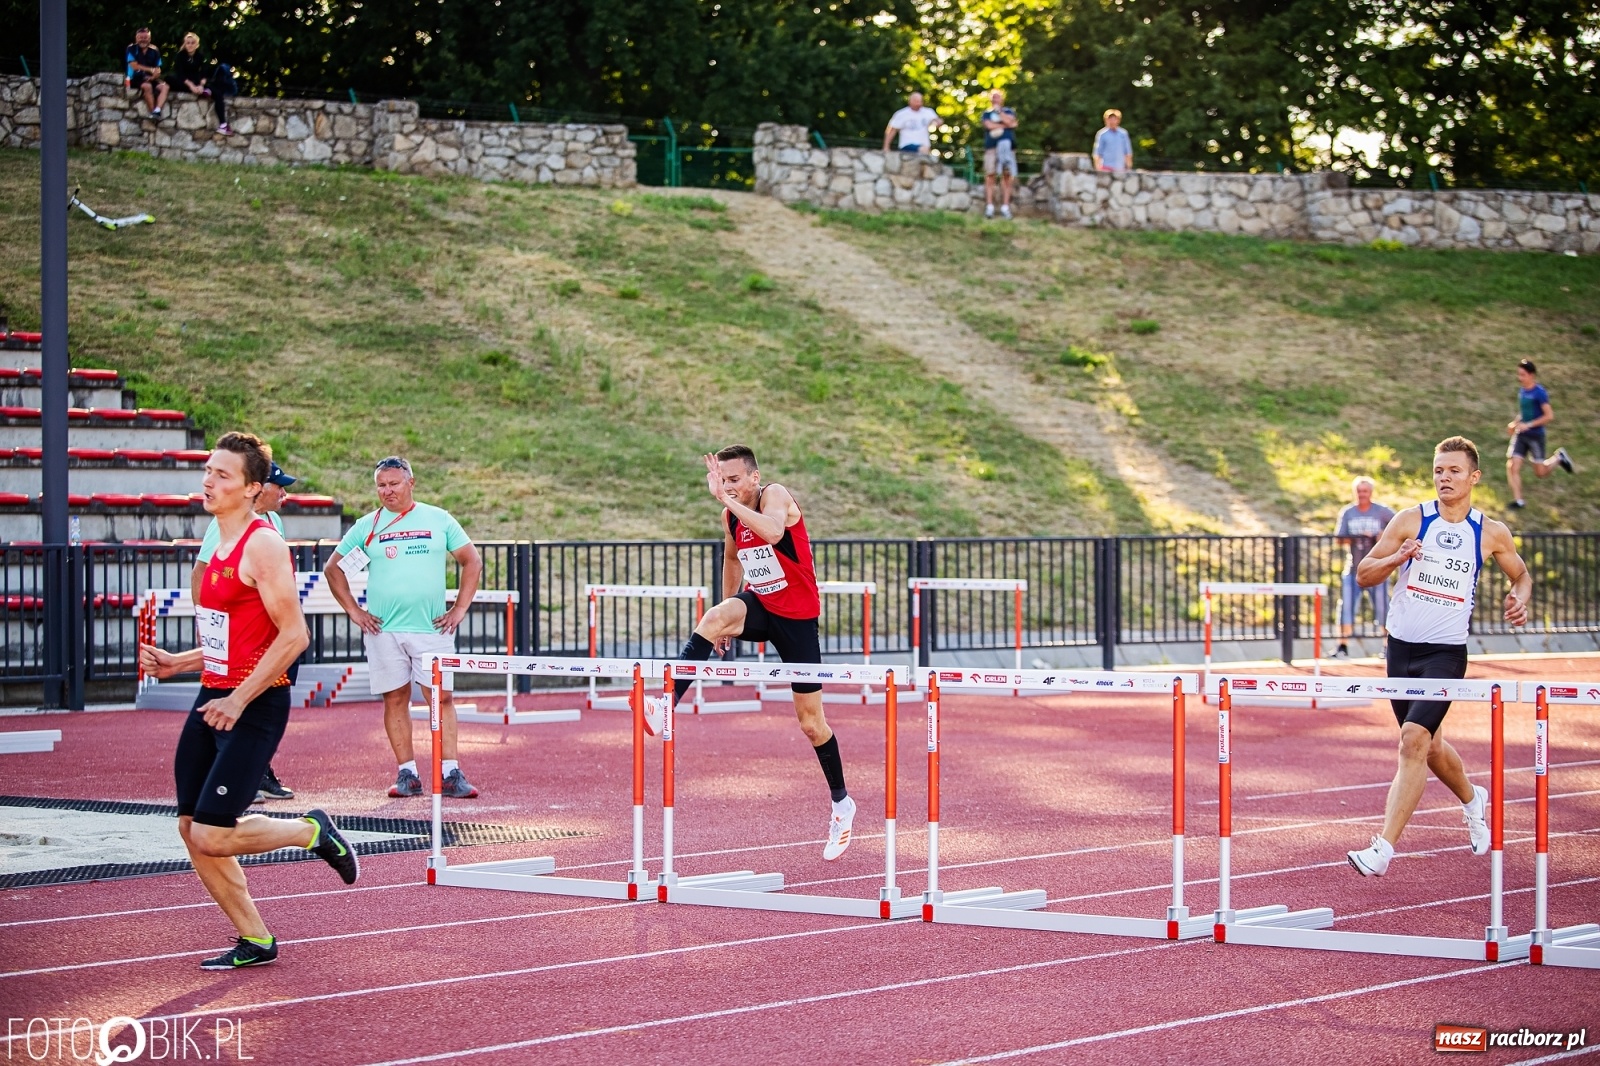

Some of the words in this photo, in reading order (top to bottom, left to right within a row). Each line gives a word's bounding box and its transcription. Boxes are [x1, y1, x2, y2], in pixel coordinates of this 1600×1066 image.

[753, 547, 773, 560] 321
[1444, 558, 1470, 573] 353
[1418, 572, 1459, 590] BILIŃSKI
[1442, 600, 1457, 608] 2019
[210, 612, 225, 628] 547
[526, 663, 537, 671] 4F
[769, 669, 781, 677] 4F
[1042, 676, 1056, 685] 4F
[1346, 684, 1361, 694] 4F
